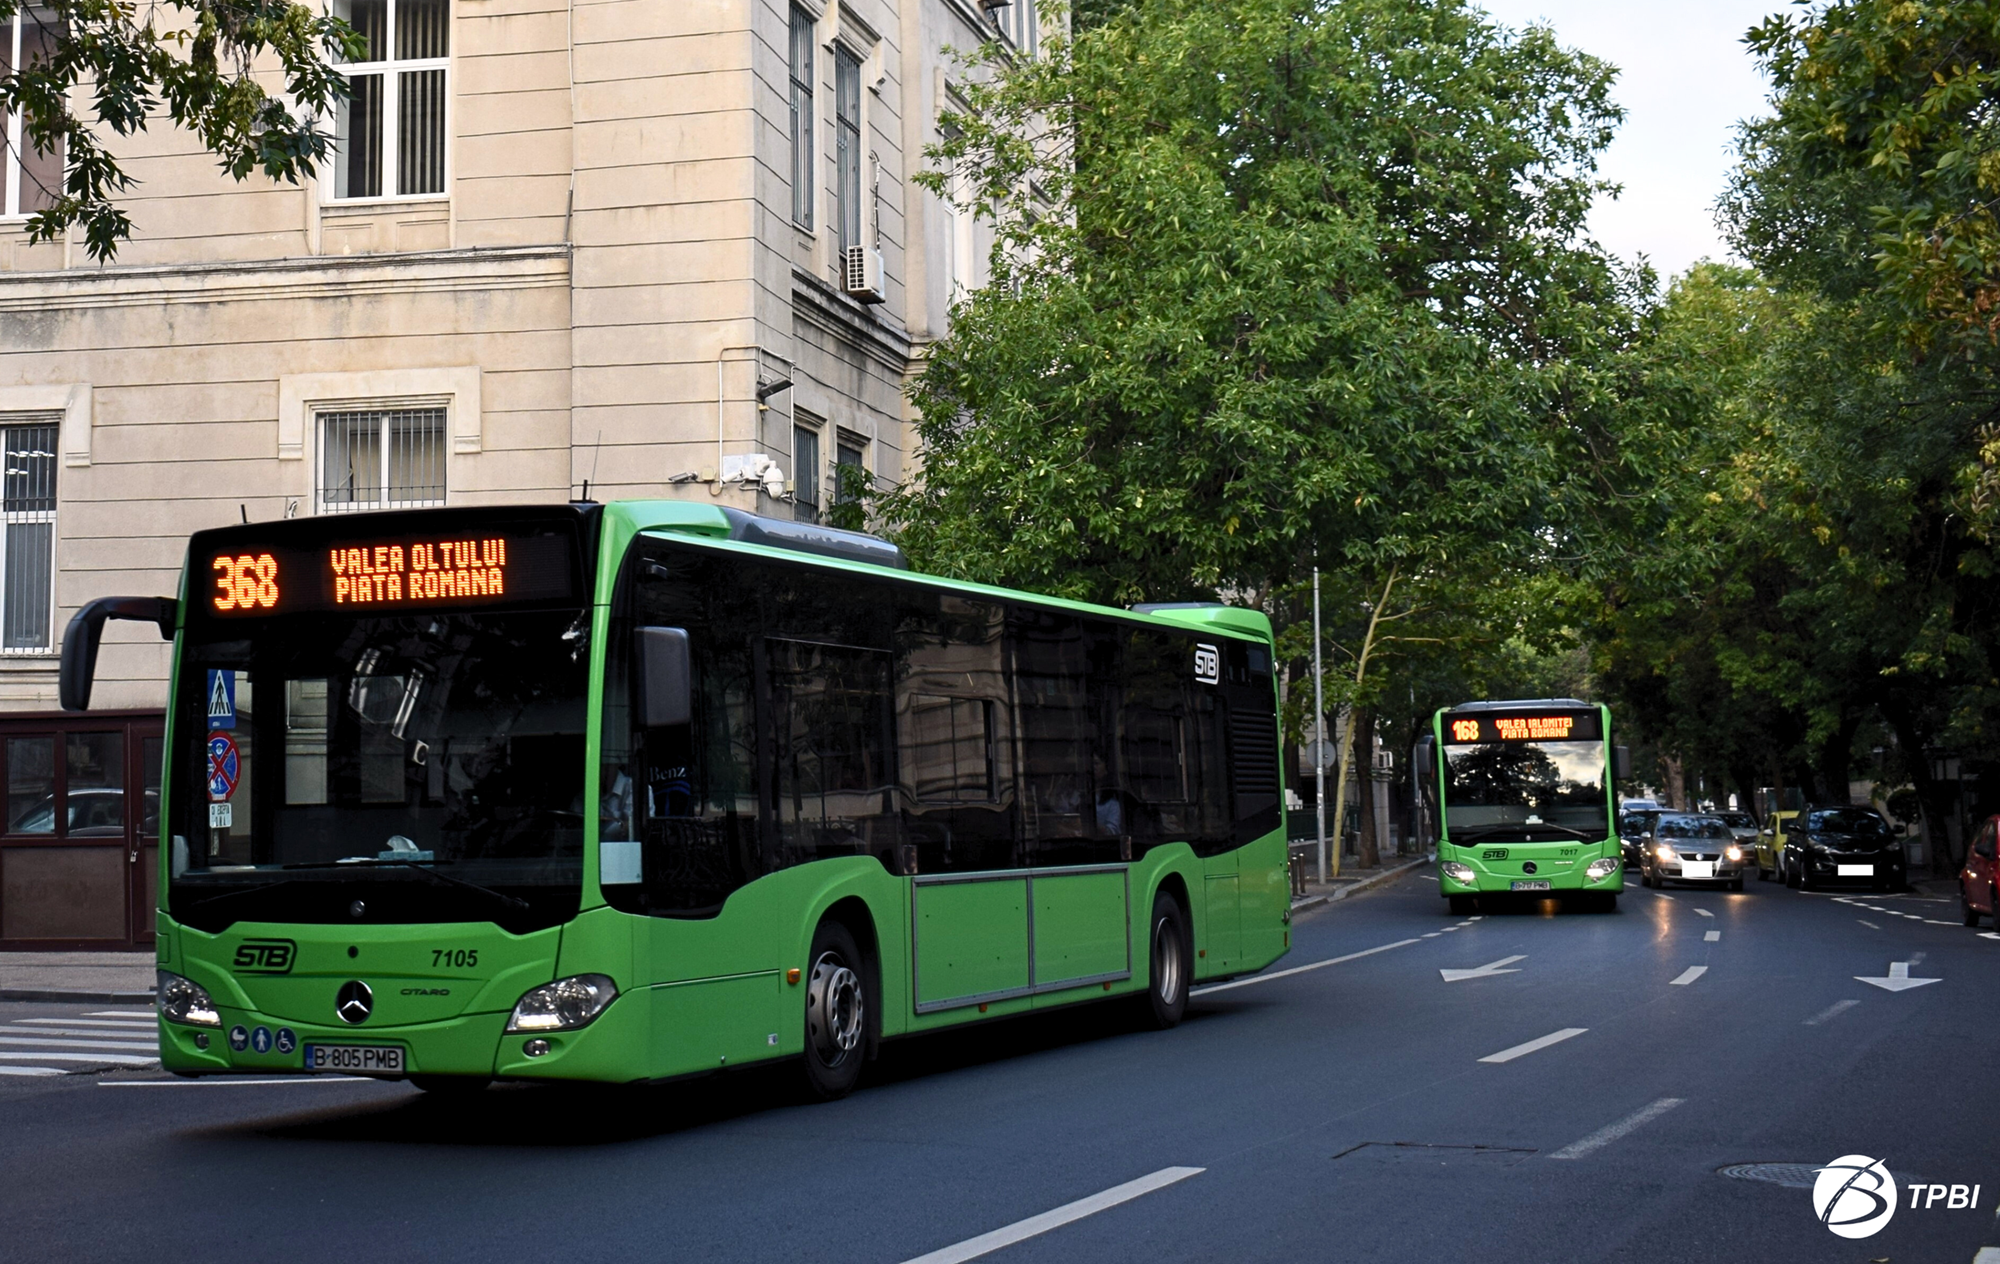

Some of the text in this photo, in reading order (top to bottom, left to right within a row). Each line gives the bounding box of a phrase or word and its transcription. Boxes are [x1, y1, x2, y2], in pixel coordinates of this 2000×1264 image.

[331, 539, 506, 575] VALEA OLTULUI
[213, 554, 278, 609] 368
[336, 567, 504, 603] PIATA ROMANA
[1195, 647, 1218, 680] STB
[1452, 720, 1479, 740] 168
[1495, 717, 1573, 729] VALEA IALOMITEI
[1501, 727, 1569, 739] PIATA ROMANA
[649, 766, 687, 782] Benz
[1482, 849, 1508, 860] STB
[1560, 848, 1578, 856] 7017
[233, 942, 293, 970] STB
[431, 949, 478, 968] 7105
[400, 987, 450, 996] CITARO
